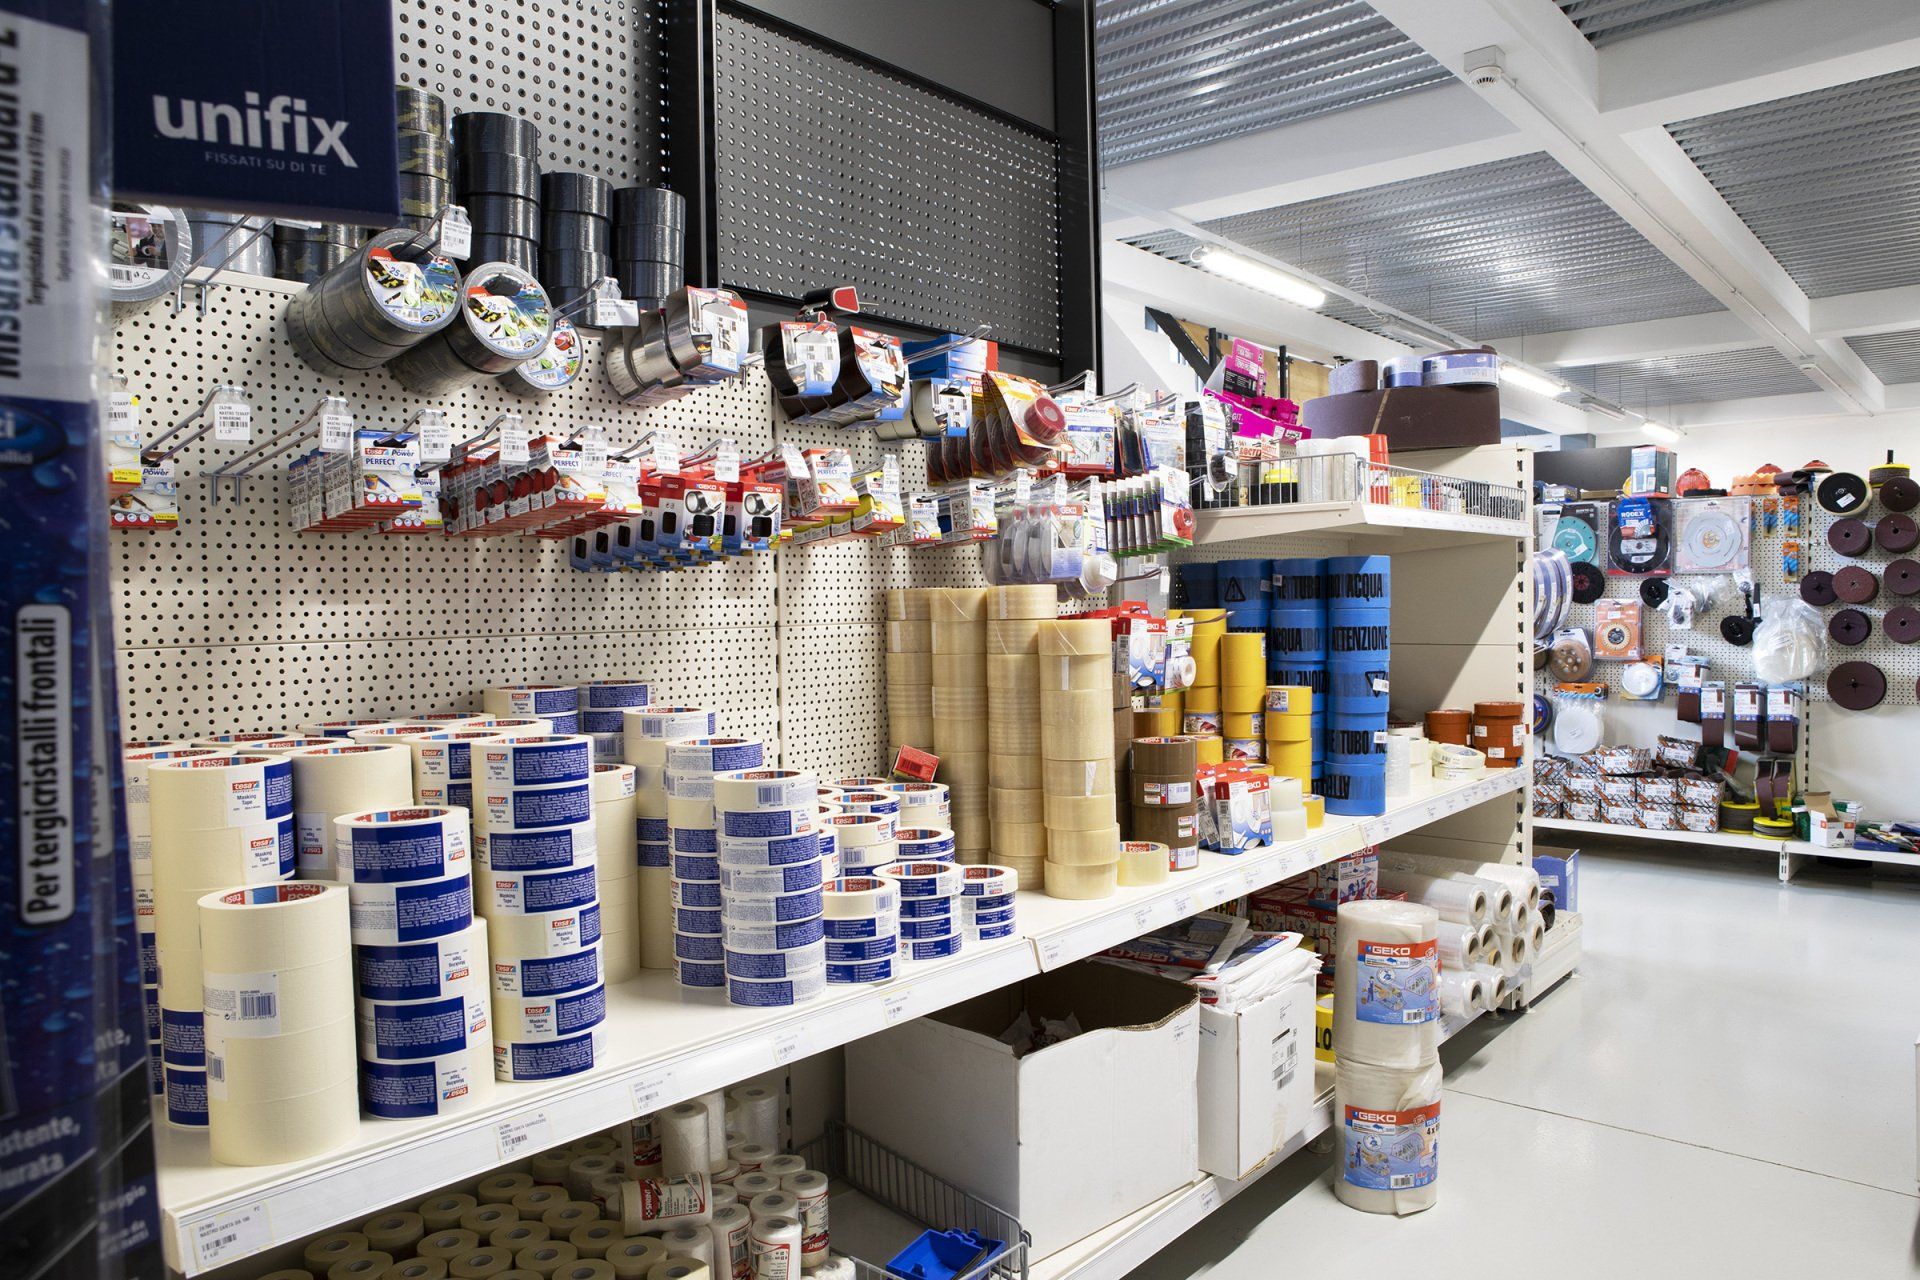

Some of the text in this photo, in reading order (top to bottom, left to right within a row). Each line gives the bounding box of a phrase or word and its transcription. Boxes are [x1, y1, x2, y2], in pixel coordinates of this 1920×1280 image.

[153, 91, 359, 168] unifix
[205, 151, 327, 176] FISSATI SU DI TE
[391, 449, 415, 457] Power
[365, 458, 396, 466] PERFECT
[142, 468, 169, 477] Power
[415, 477, 437, 486] Power
[1346, 573, 1383, 602] ACQUA
[1332, 626, 1388, 652] ATTENZIONE
[1340, 730, 1370, 755] TUBO
[21, 615, 67, 914] Per tergicristalli frontali
[195, 759, 225, 768] tesa
[234, 782, 253, 790] tesa
[1247, 781, 1261, 789] EKO
[255, 851, 273, 859] Masking
[556, 930, 574, 938] Masking
[1372, 946, 1410, 956] GEKO
[452, 969, 469, 980] tesa
[527, 1006, 544, 1015] tesa
[451, 1086, 468, 1097] tesa
[1359, 1112, 1397, 1123] GEKO
[0, 1116, 81, 1156] stente,
[0, 1153, 65, 1188] urata
